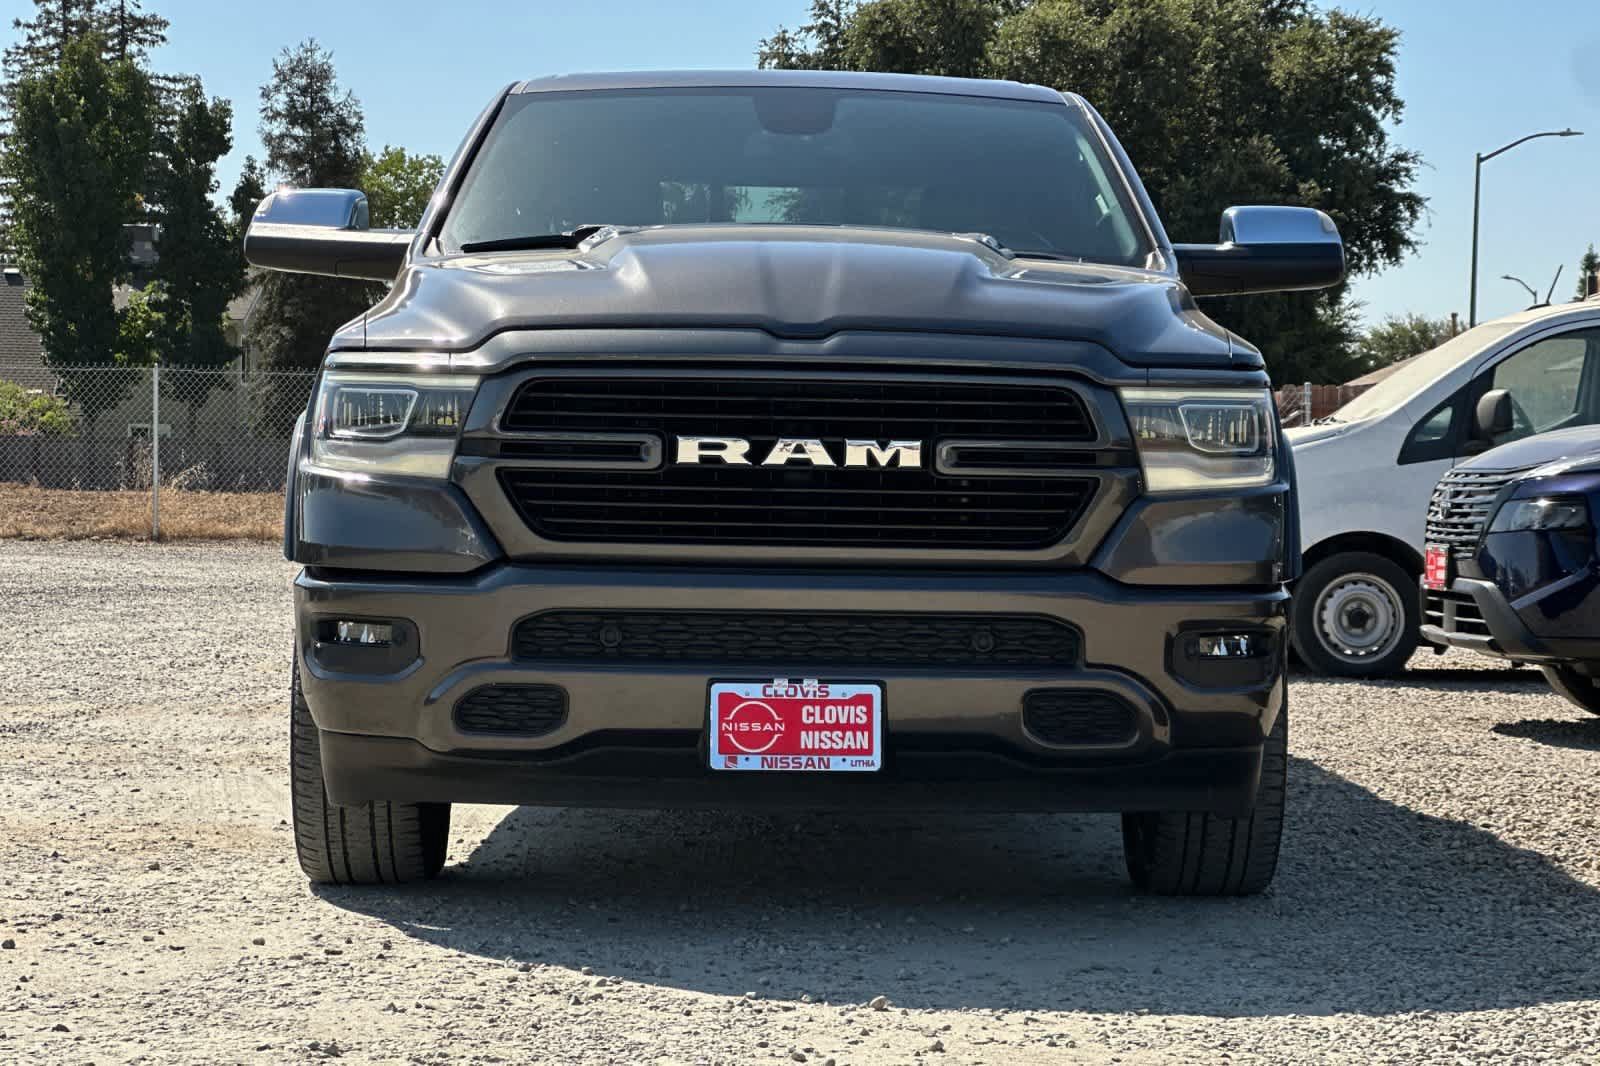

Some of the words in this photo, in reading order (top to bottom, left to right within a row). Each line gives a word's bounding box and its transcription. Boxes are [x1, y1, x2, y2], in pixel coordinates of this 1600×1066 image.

[677, 435, 921, 468] RAM
[762, 683, 830, 698] CLOVIS
[802, 705, 867, 724] CLOVIS
[722, 722, 784, 732] NISSAN
[801, 731, 868, 750] NISSAN
[761, 756, 831, 769] NISSAN
[850, 759, 875, 768] LITHIA
